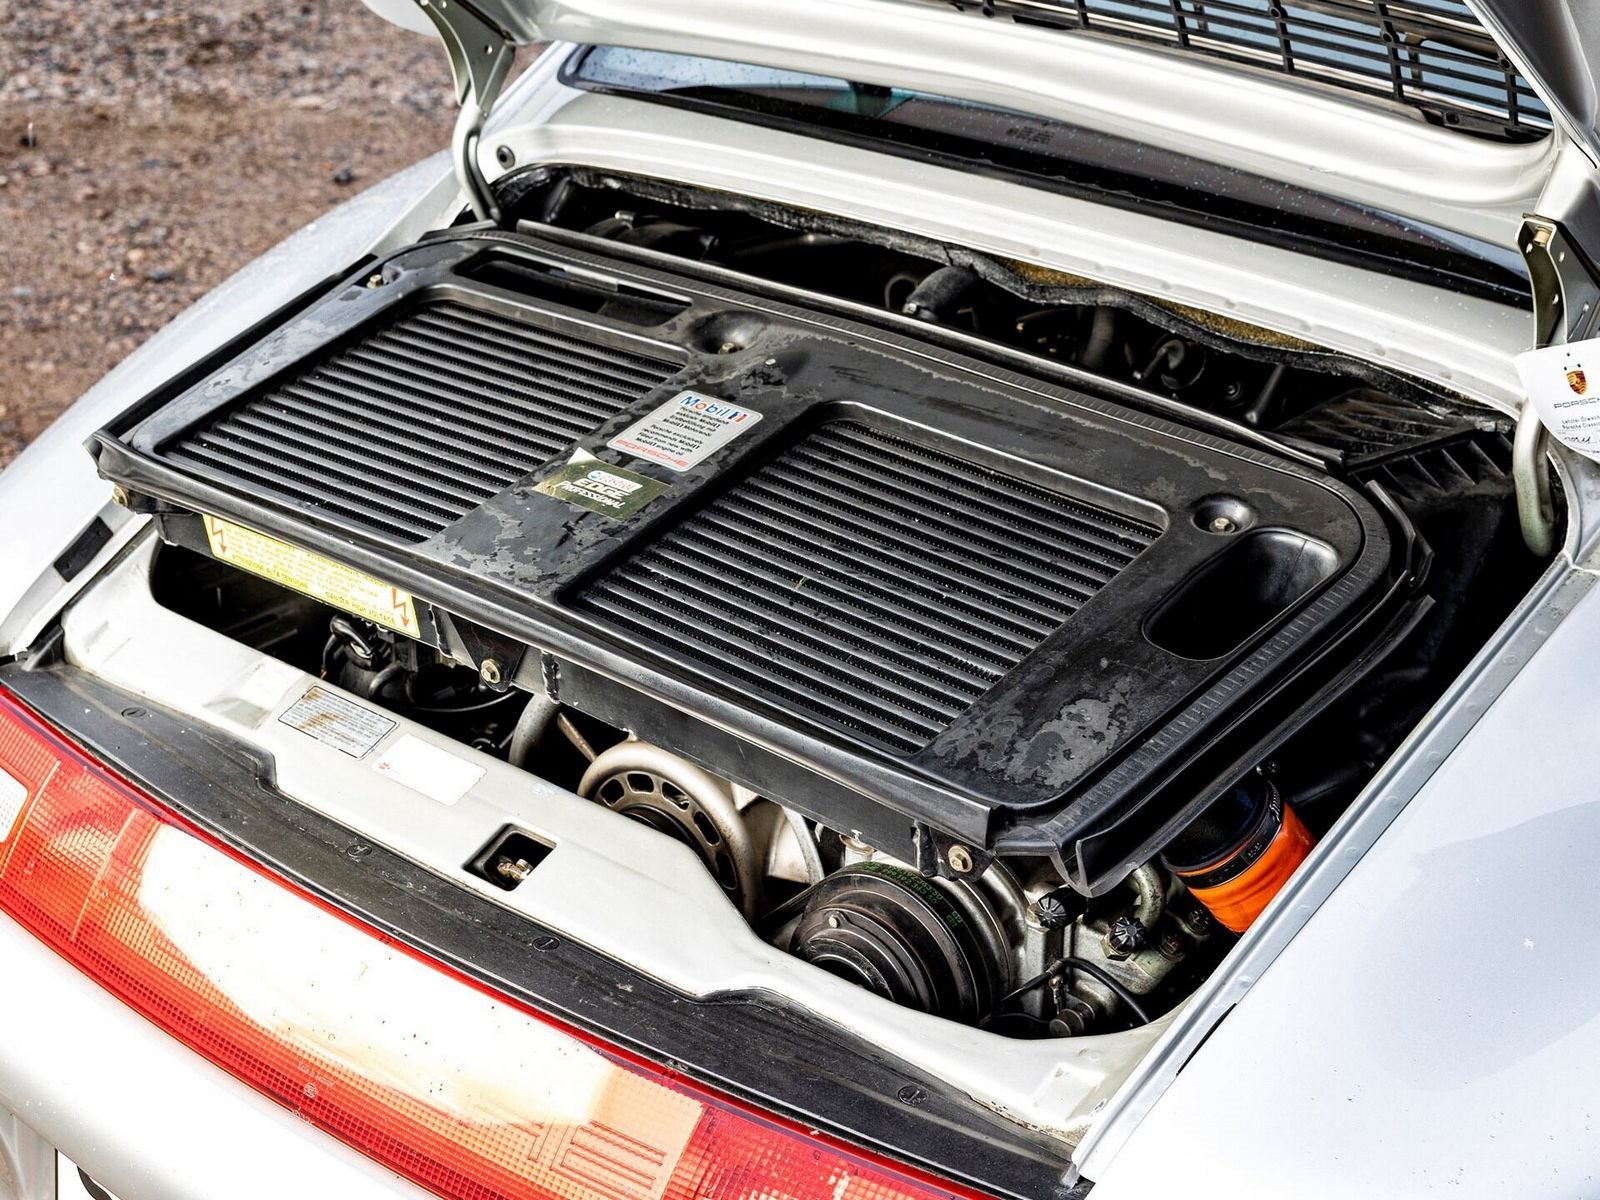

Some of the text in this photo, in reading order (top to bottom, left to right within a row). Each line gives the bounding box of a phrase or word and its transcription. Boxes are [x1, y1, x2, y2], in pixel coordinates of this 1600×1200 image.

[680, 396, 731, 416] Mobil
[1553, 397, 1600, 408] PORSC
[615, 439, 689, 467] PORSCHE
[572, 479, 630, 501] EDGE
